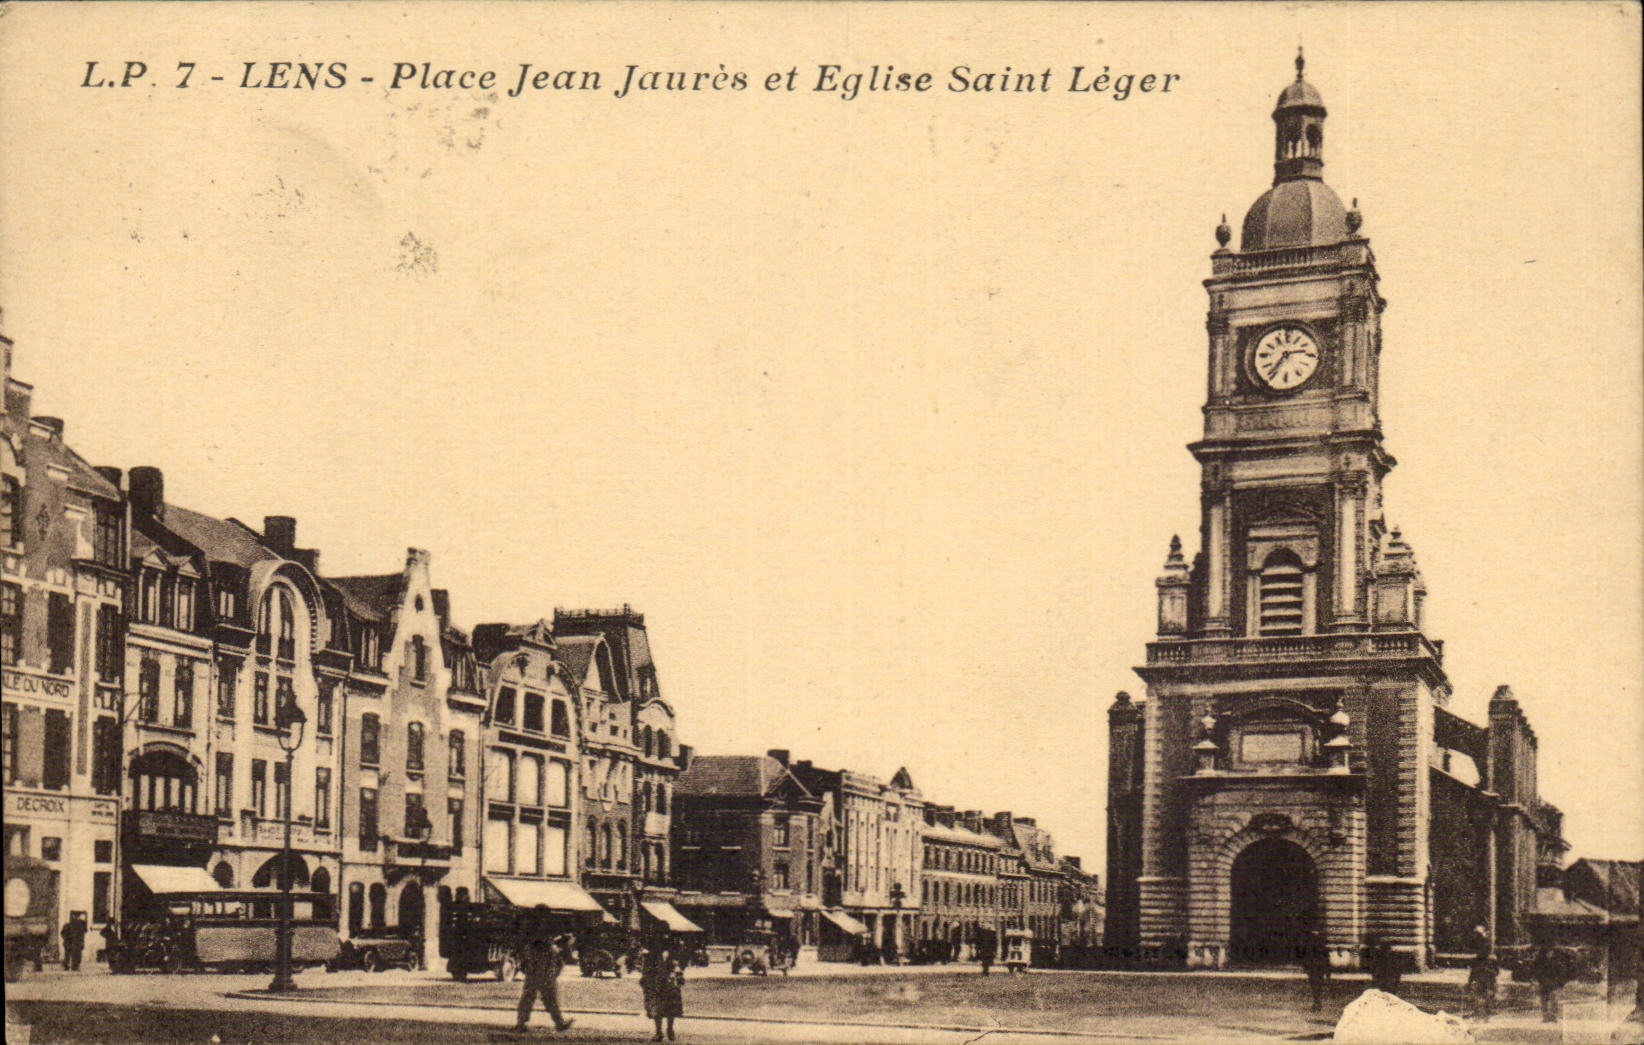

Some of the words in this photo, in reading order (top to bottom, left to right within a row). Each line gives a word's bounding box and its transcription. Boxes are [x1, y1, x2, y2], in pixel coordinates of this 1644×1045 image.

[23, 677, 39, 693] DU
[41, 679, 70, 698] NORD
[17, 796, 65, 813] DECROIX
